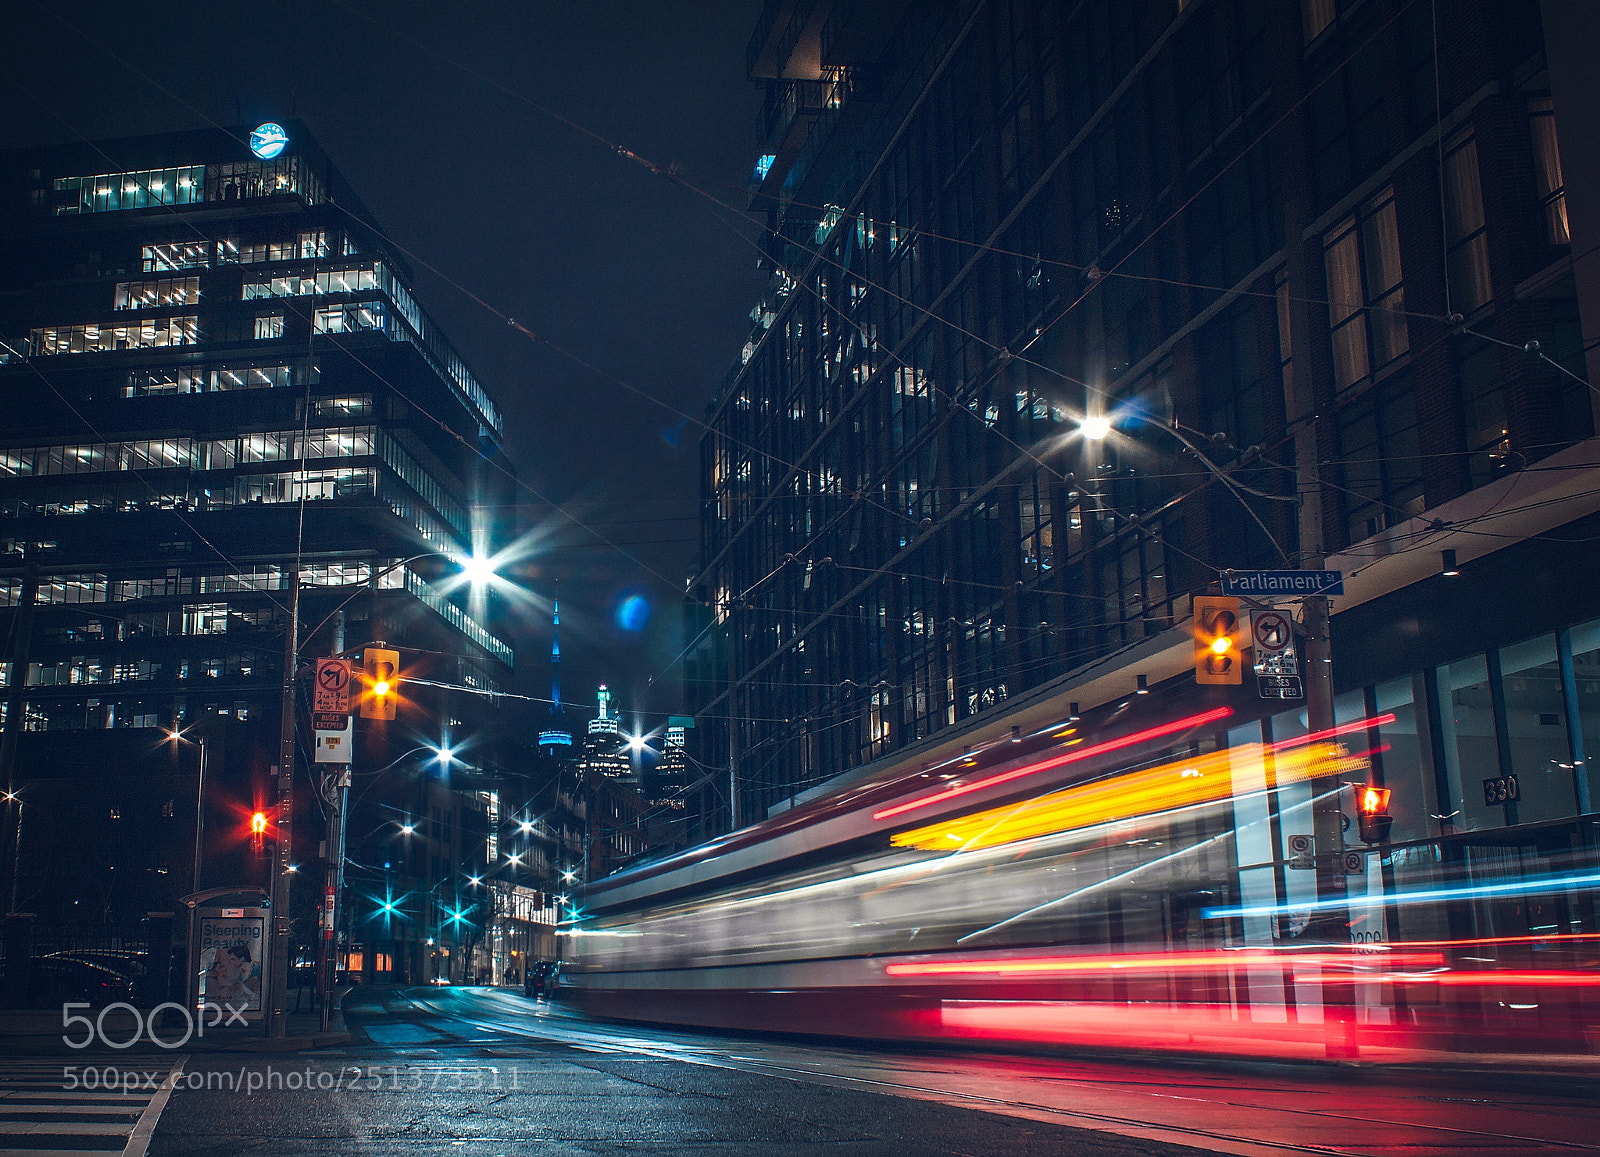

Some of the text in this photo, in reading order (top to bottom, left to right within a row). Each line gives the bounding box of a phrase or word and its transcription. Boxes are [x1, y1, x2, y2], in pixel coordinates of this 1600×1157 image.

[1229, 573, 1335, 590] Parliament St
[1486, 776, 1517, 802] 330
[203, 924, 261, 939] Sleeping
